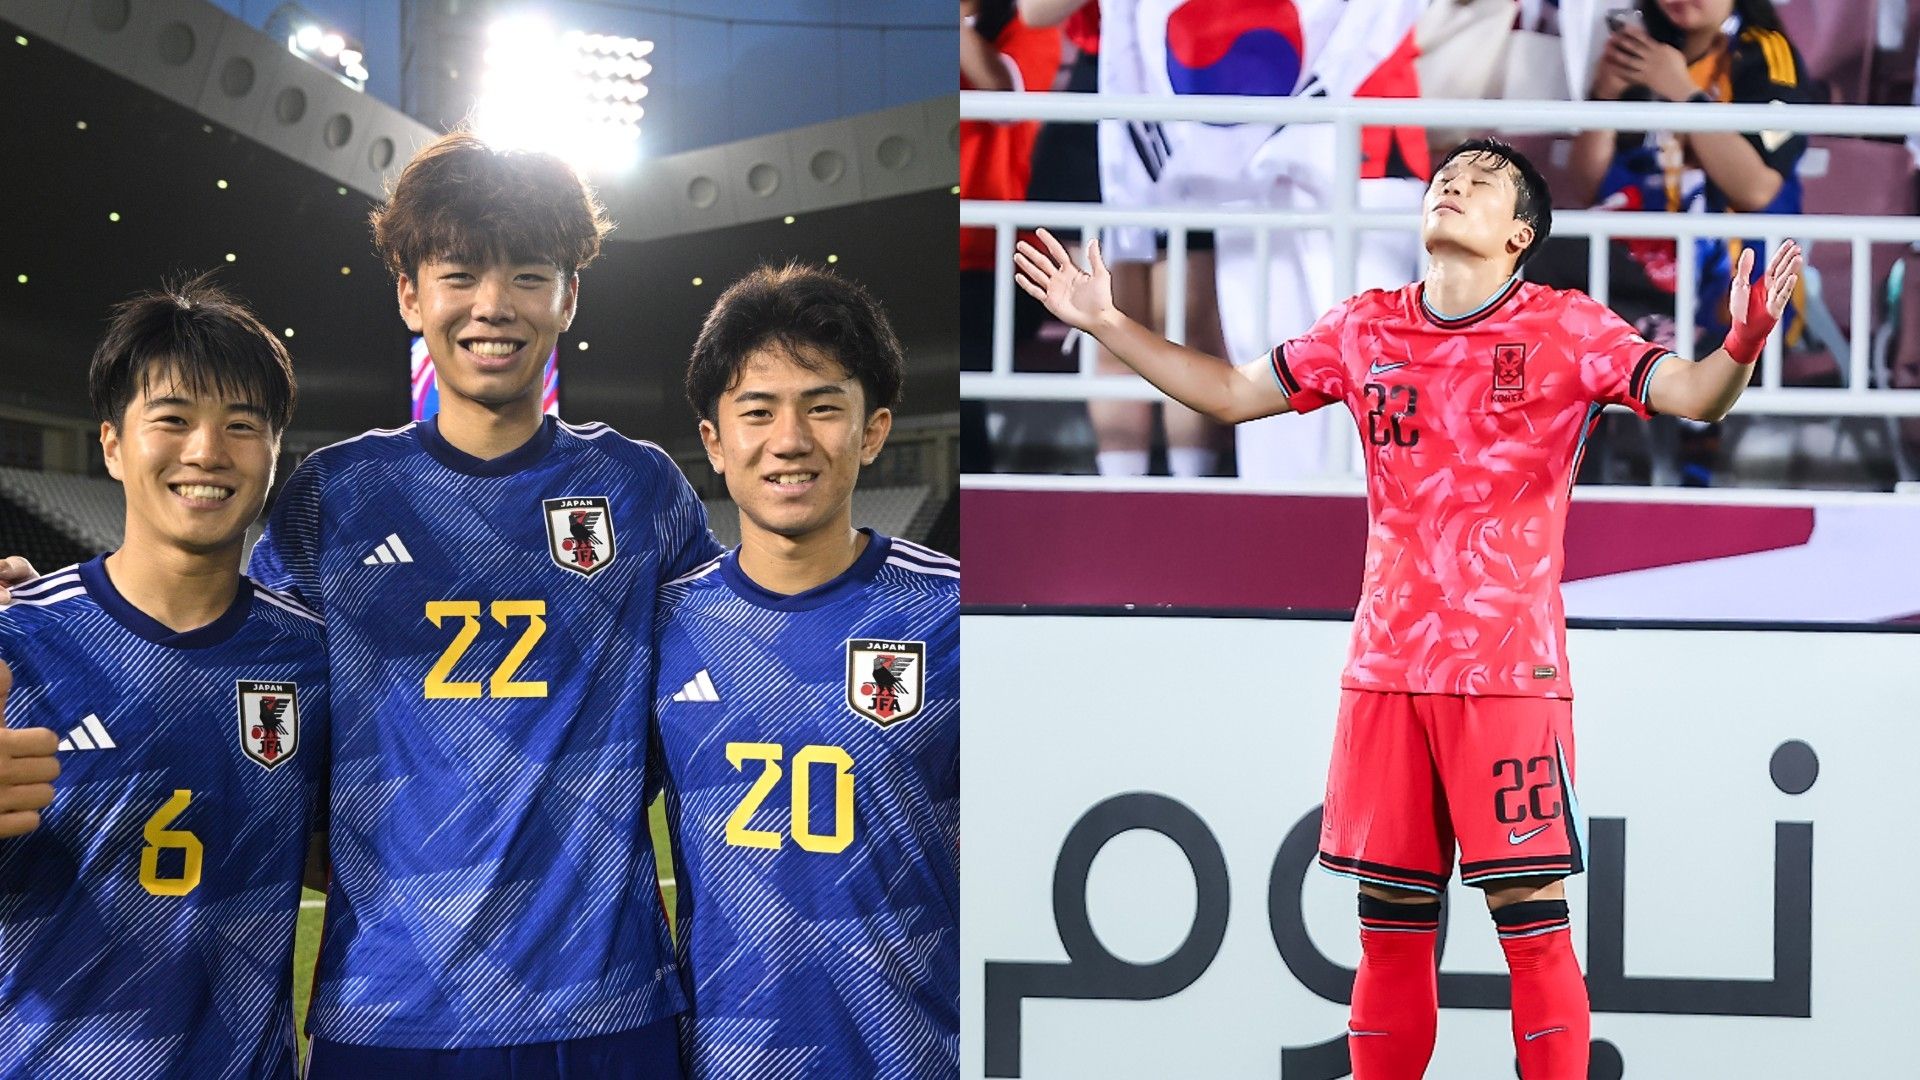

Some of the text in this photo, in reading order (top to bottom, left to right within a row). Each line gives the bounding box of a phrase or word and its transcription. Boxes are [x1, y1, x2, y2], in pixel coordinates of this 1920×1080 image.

[1364, 384, 1419, 447] 22
[560, 500, 593, 508] JAPAN
[570, 549, 600, 563] JFA
[424, 600, 548, 699] 22
[866, 642, 906, 651] JAPAN
[252, 684, 283, 692] JAPAN
[867, 697, 902, 712] JFA
[257, 740, 284, 754] JFA
[1493, 755, 1561, 824] 22
[725, 742, 855, 854] 20
[139, 789, 204, 896] 6
